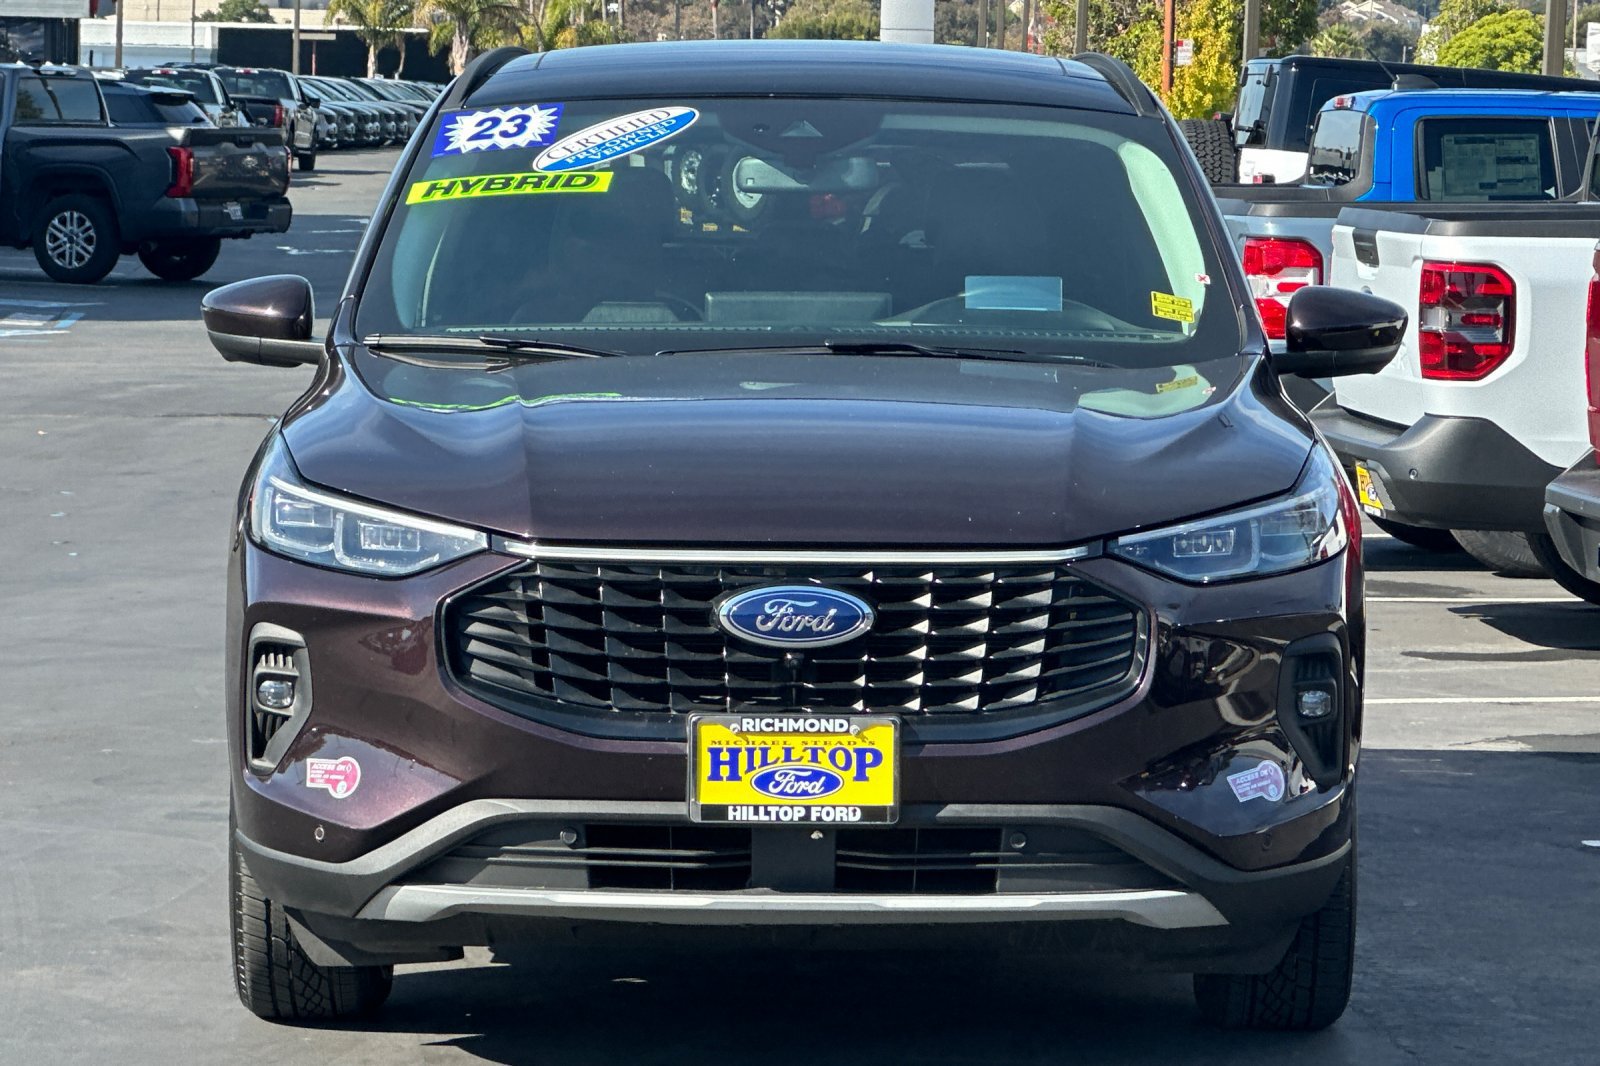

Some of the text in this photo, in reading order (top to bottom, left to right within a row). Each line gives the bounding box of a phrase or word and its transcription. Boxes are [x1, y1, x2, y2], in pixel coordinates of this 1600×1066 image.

[466, 113, 532, 142] 23
[546, 110, 671, 160] CERTIFIED
[565, 118, 677, 164] PRE-OWNED
[586, 128, 671, 161] VEHICLE
[422, 172, 600, 200] HYBRID
[755, 598, 838, 632] Ford
[741, 718, 849, 733] RICHMOND
[706, 745, 884, 782] HILLTOP
[767, 769, 825, 795] Ford
[727, 806, 862, 822] HILLTOP FORD
